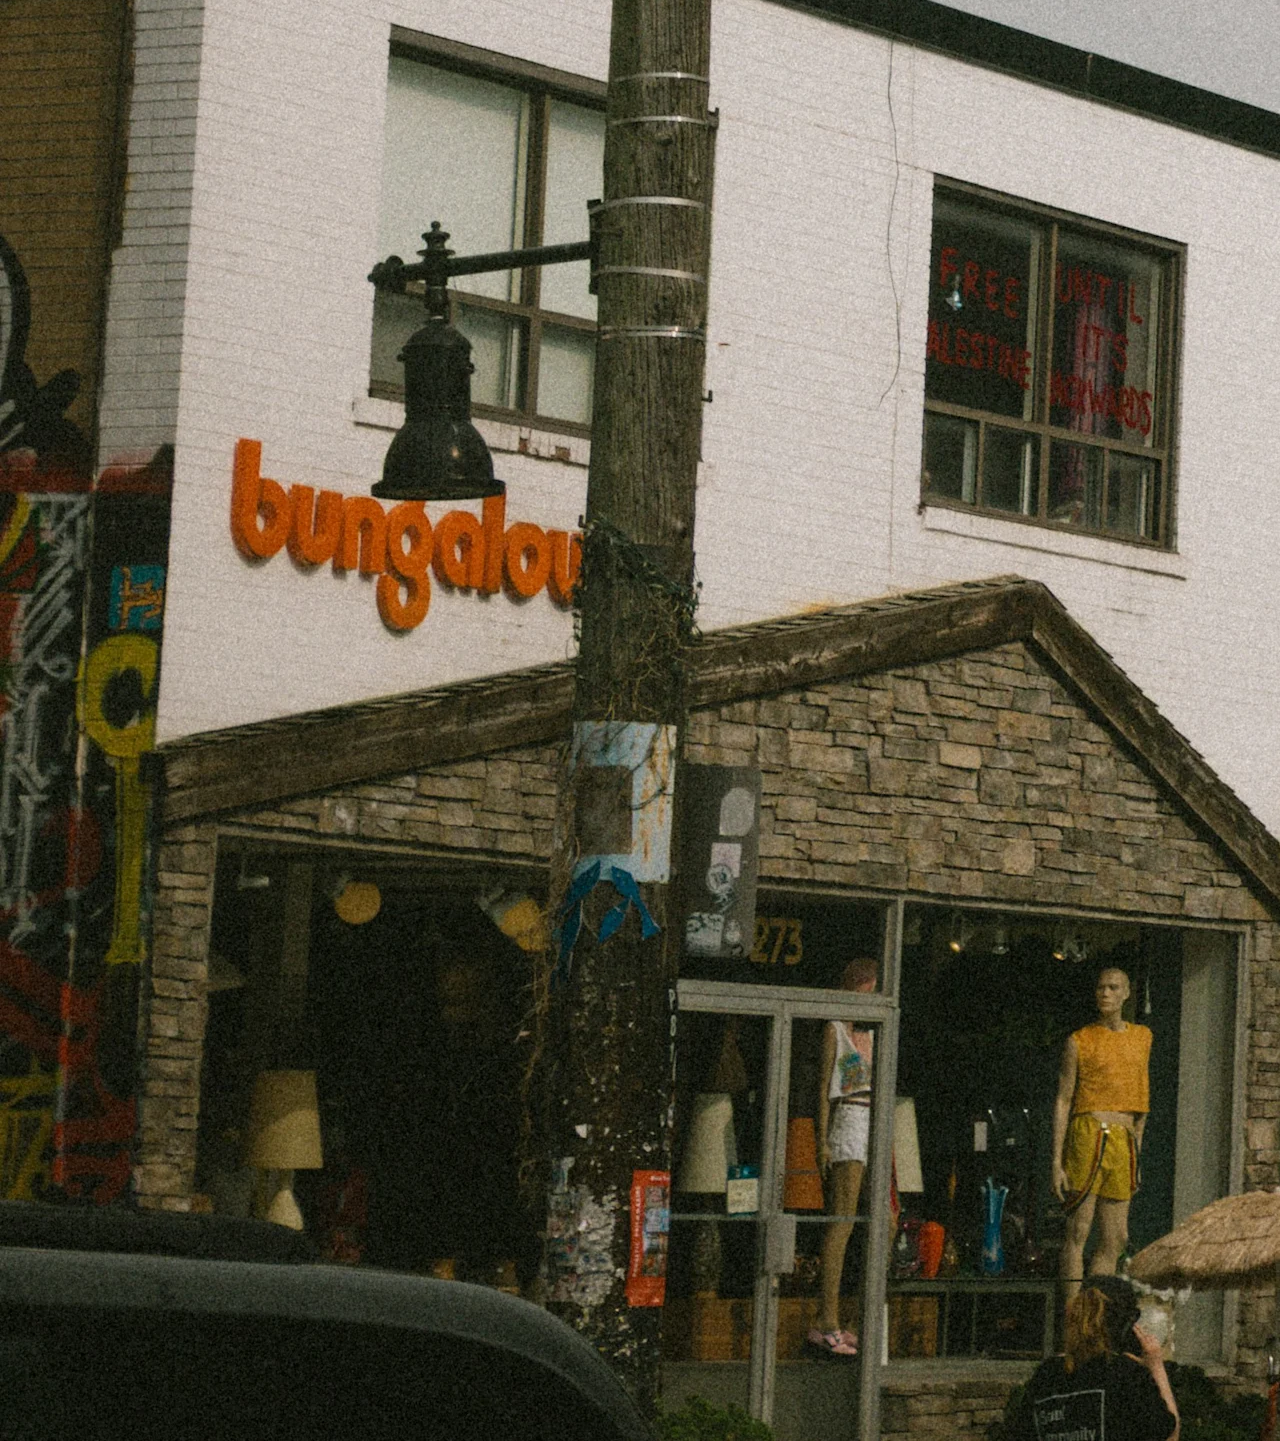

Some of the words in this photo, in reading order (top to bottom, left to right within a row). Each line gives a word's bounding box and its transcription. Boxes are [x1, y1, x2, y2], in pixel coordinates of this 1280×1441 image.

[939, 246, 1021, 319] FREE
[1054, 261, 1143, 325] UNTIL
[927, 317, 1032, 390] ALESTINE
[749, 916, 803, 966] 273
